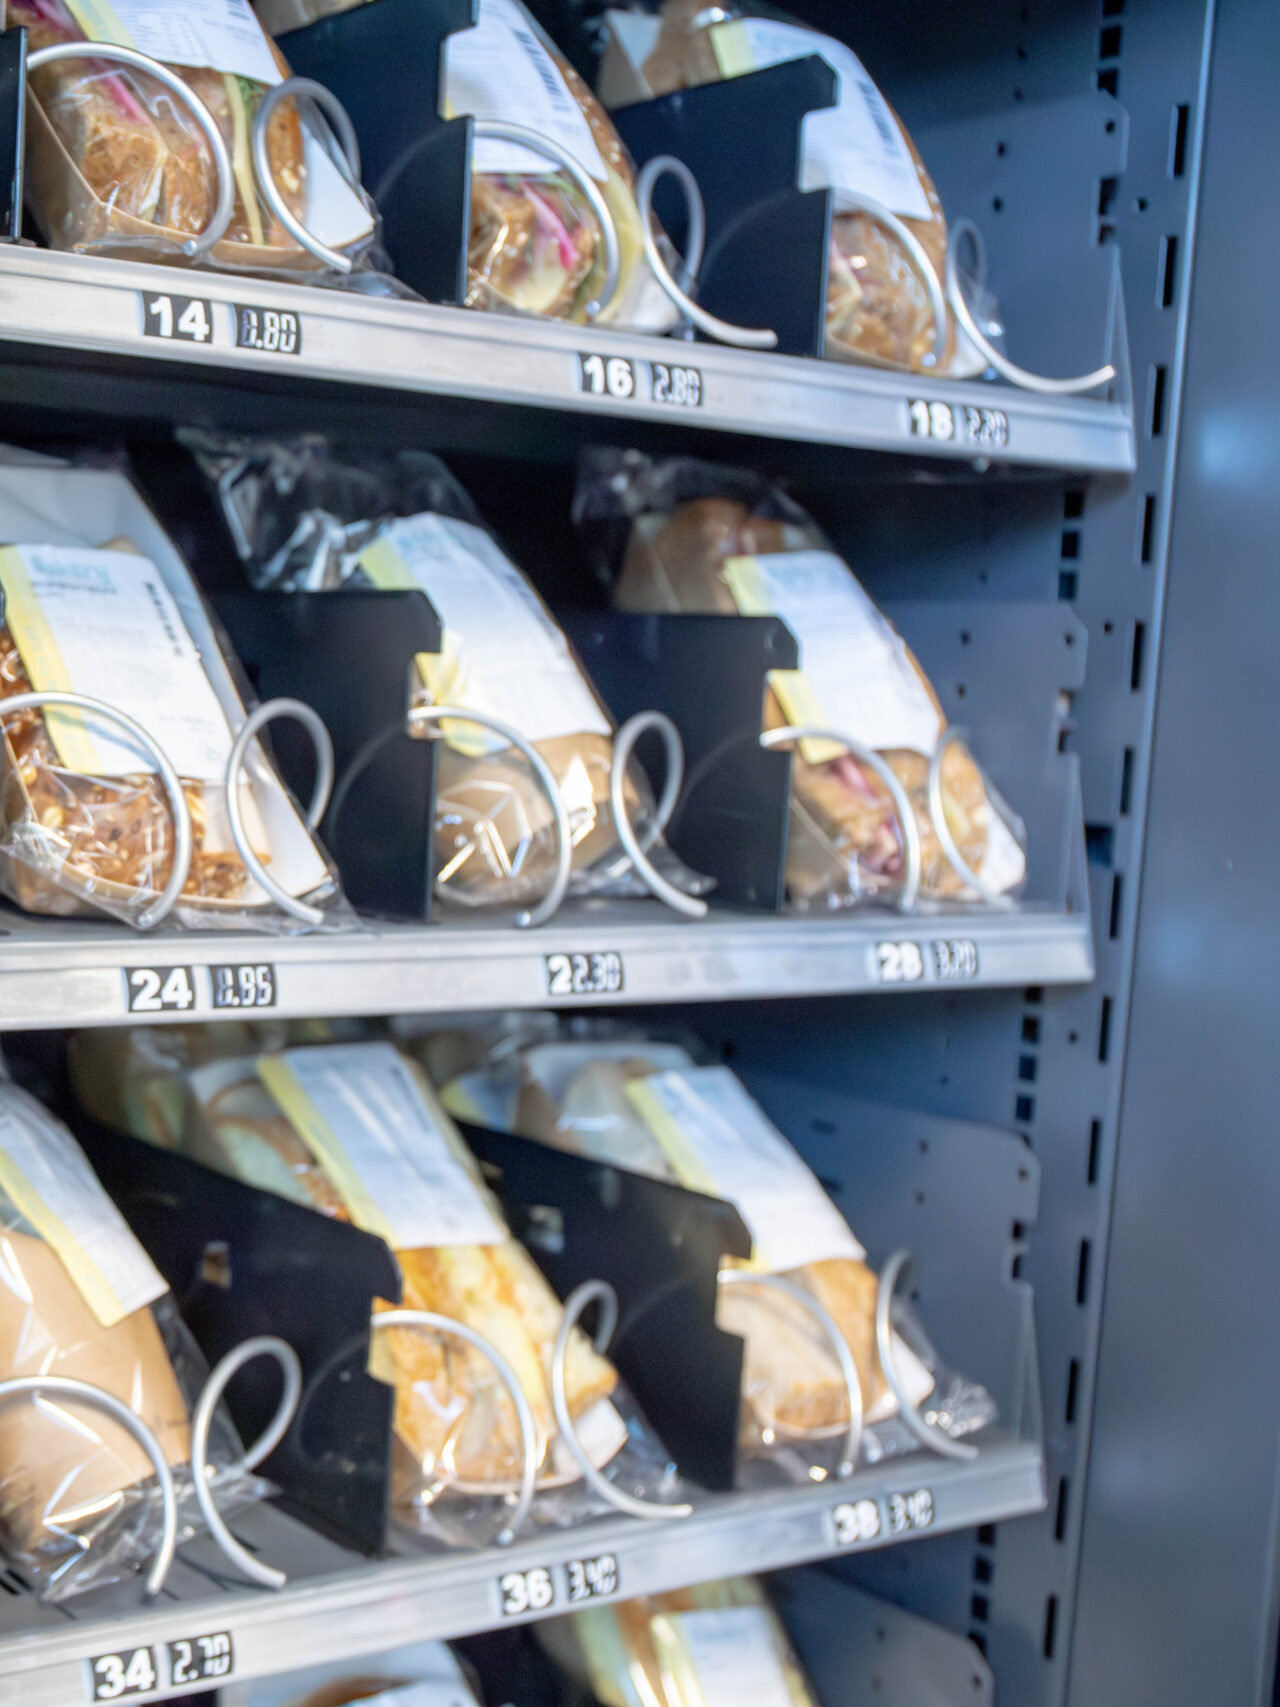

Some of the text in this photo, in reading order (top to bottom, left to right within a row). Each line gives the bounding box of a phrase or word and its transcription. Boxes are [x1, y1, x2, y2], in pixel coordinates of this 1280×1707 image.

[149, 296, 297, 352] 14 1.80
[583, 355, 700, 406] 16 2.80
[911, 400, 953, 440] 18
[878, 942, 923, 982] 28
[131, 966, 273, 1010] 24 1.95
[833, 1499, 880, 1544] 38
[500, 1568, 553, 1614] 36
[94, 1633, 230, 1698] 34 2.70
